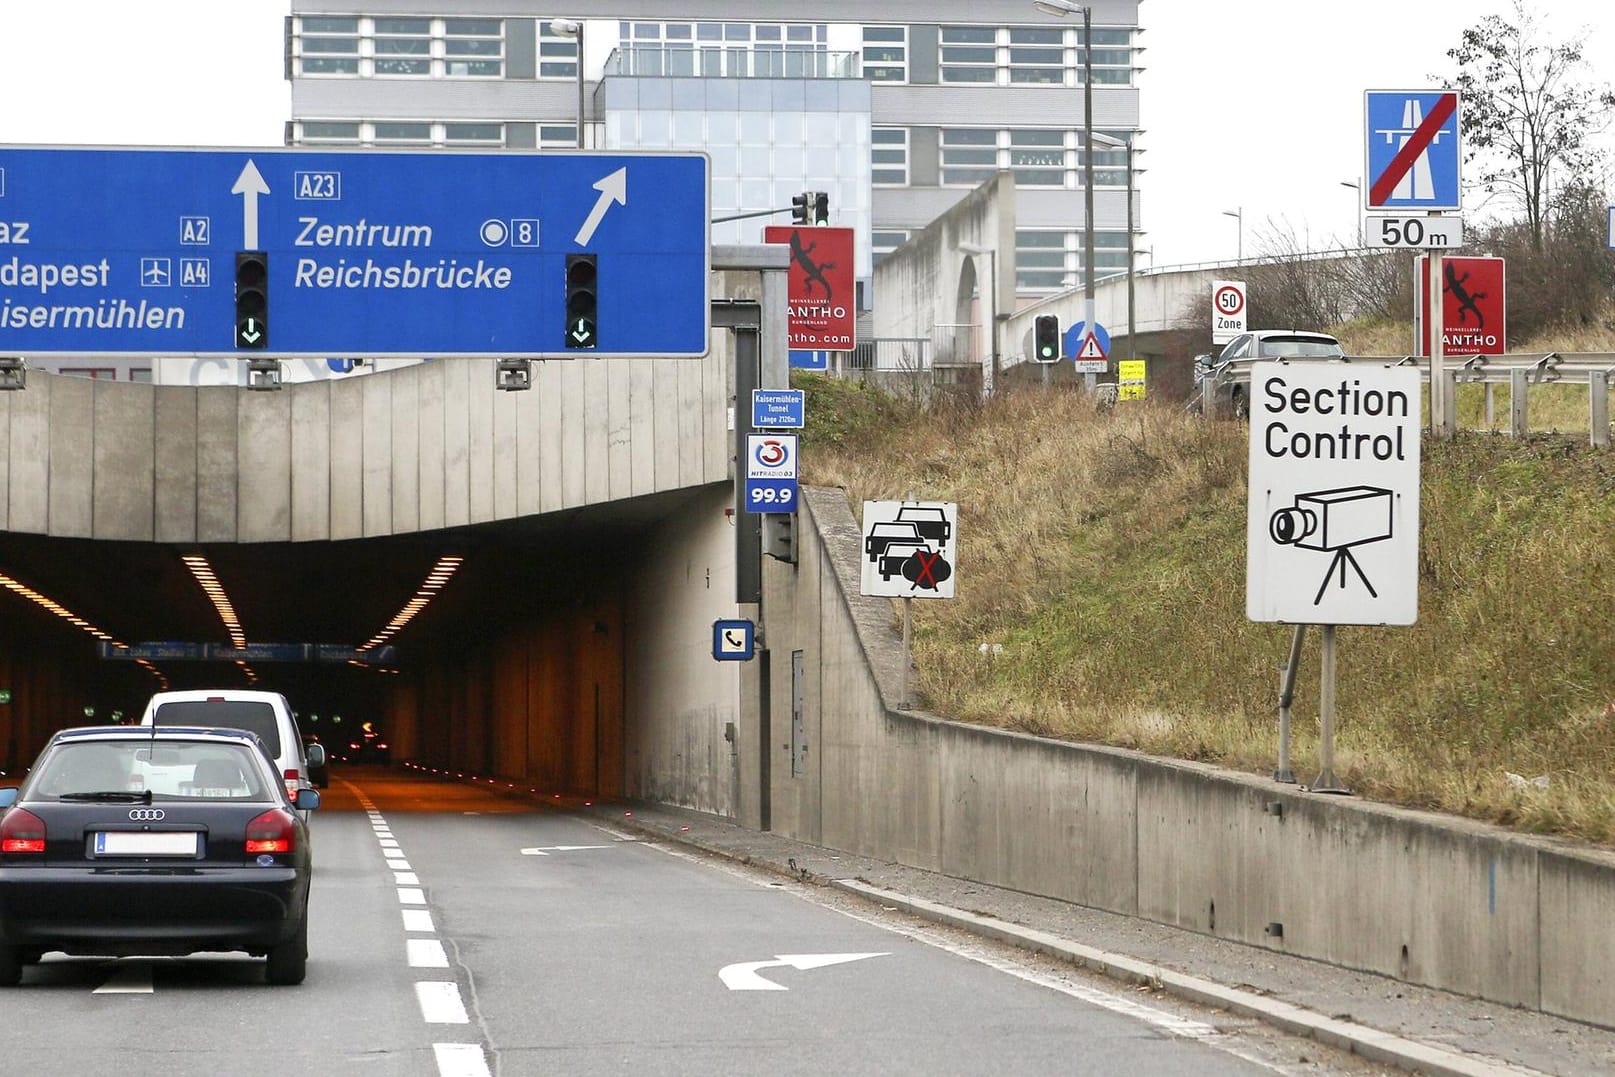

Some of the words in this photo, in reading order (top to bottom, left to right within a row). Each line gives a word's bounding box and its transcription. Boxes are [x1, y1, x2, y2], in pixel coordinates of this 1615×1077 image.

[300, 174, 335, 197] A23
[0, 222, 30, 244] az
[183, 221, 207, 242] A2
[294, 216, 433, 247] Zentrum
[518, 222, 532, 244] 8
[1382, 218, 1424, 246] 50
[1429, 233, 1448, 246] m
[0, 256, 110, 294] dapest
[183, 261, 207, 282] A4
[294, 258, 512, 289] Reichsbrücke
[1222, 293, 1236, 308] 50
[0, 299, 185, 329] isermühlen
[788, 307, 845, 318] ANTHO
[1217, 317, 1242, 329] Zone
[1442, 335, 1497, 346] ANTHO
[755, 394, 802, 404] Kaisermühlen-
[1264, 377, 1408, 417] Section
[767, 404, 789, 413] Tunnel
[1265, 421, 1405, 461] Control
[752, 488, 792, 503] 99.9
